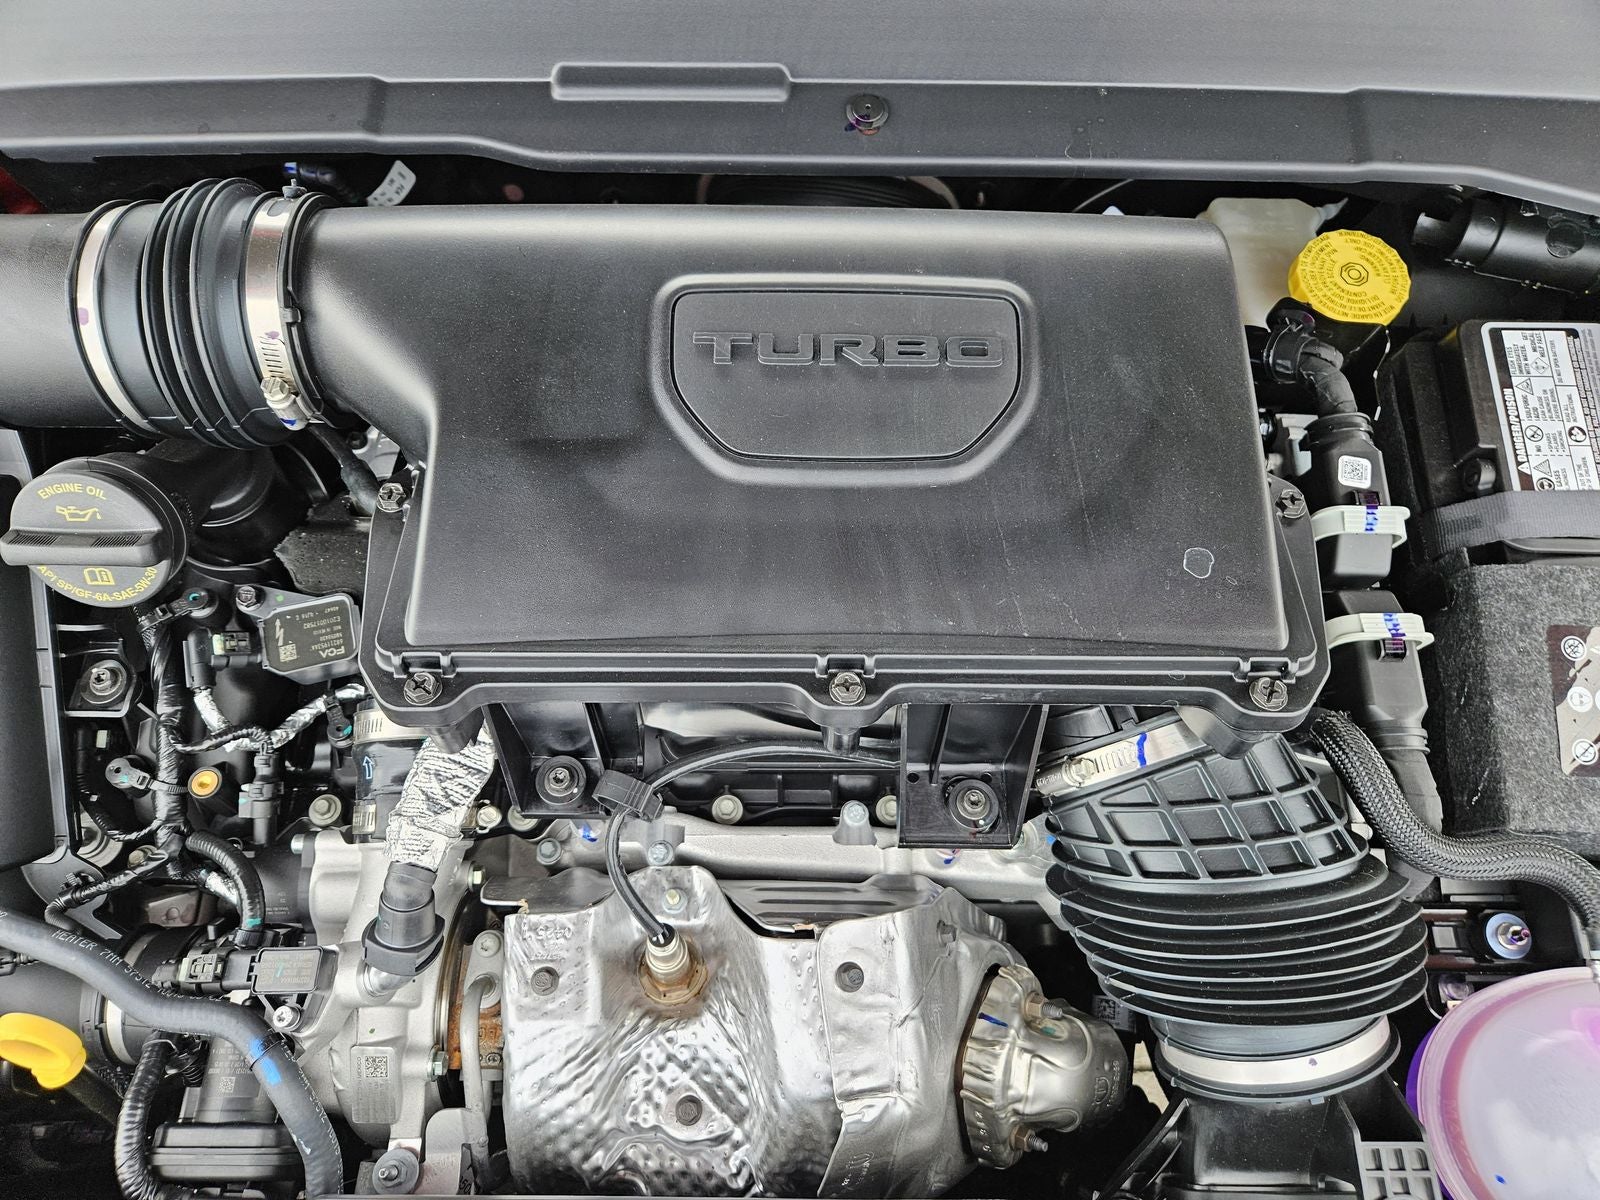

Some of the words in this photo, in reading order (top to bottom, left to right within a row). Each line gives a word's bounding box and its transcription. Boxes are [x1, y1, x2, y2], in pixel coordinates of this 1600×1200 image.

[692, 331, 1003, 368] TURBO
[1528, 332, 1537, 352] MEDICAL
[1521, 394, 1533, 418] SULFURIC
[1503, 388, 1528, 462] DANGER/POISON
[1554, 470, 1562, 487] GASES
[37, 483, 83, 499] ENGINE
[86, 486, 107, 500] OIL
[37, 565, 57, 582] API
[56, 567, 158, 602] SP/GF-6A-SAE-5W-30
[319, 646, 345, 658] FCA
[52, 929, 98, 950] HEATER
